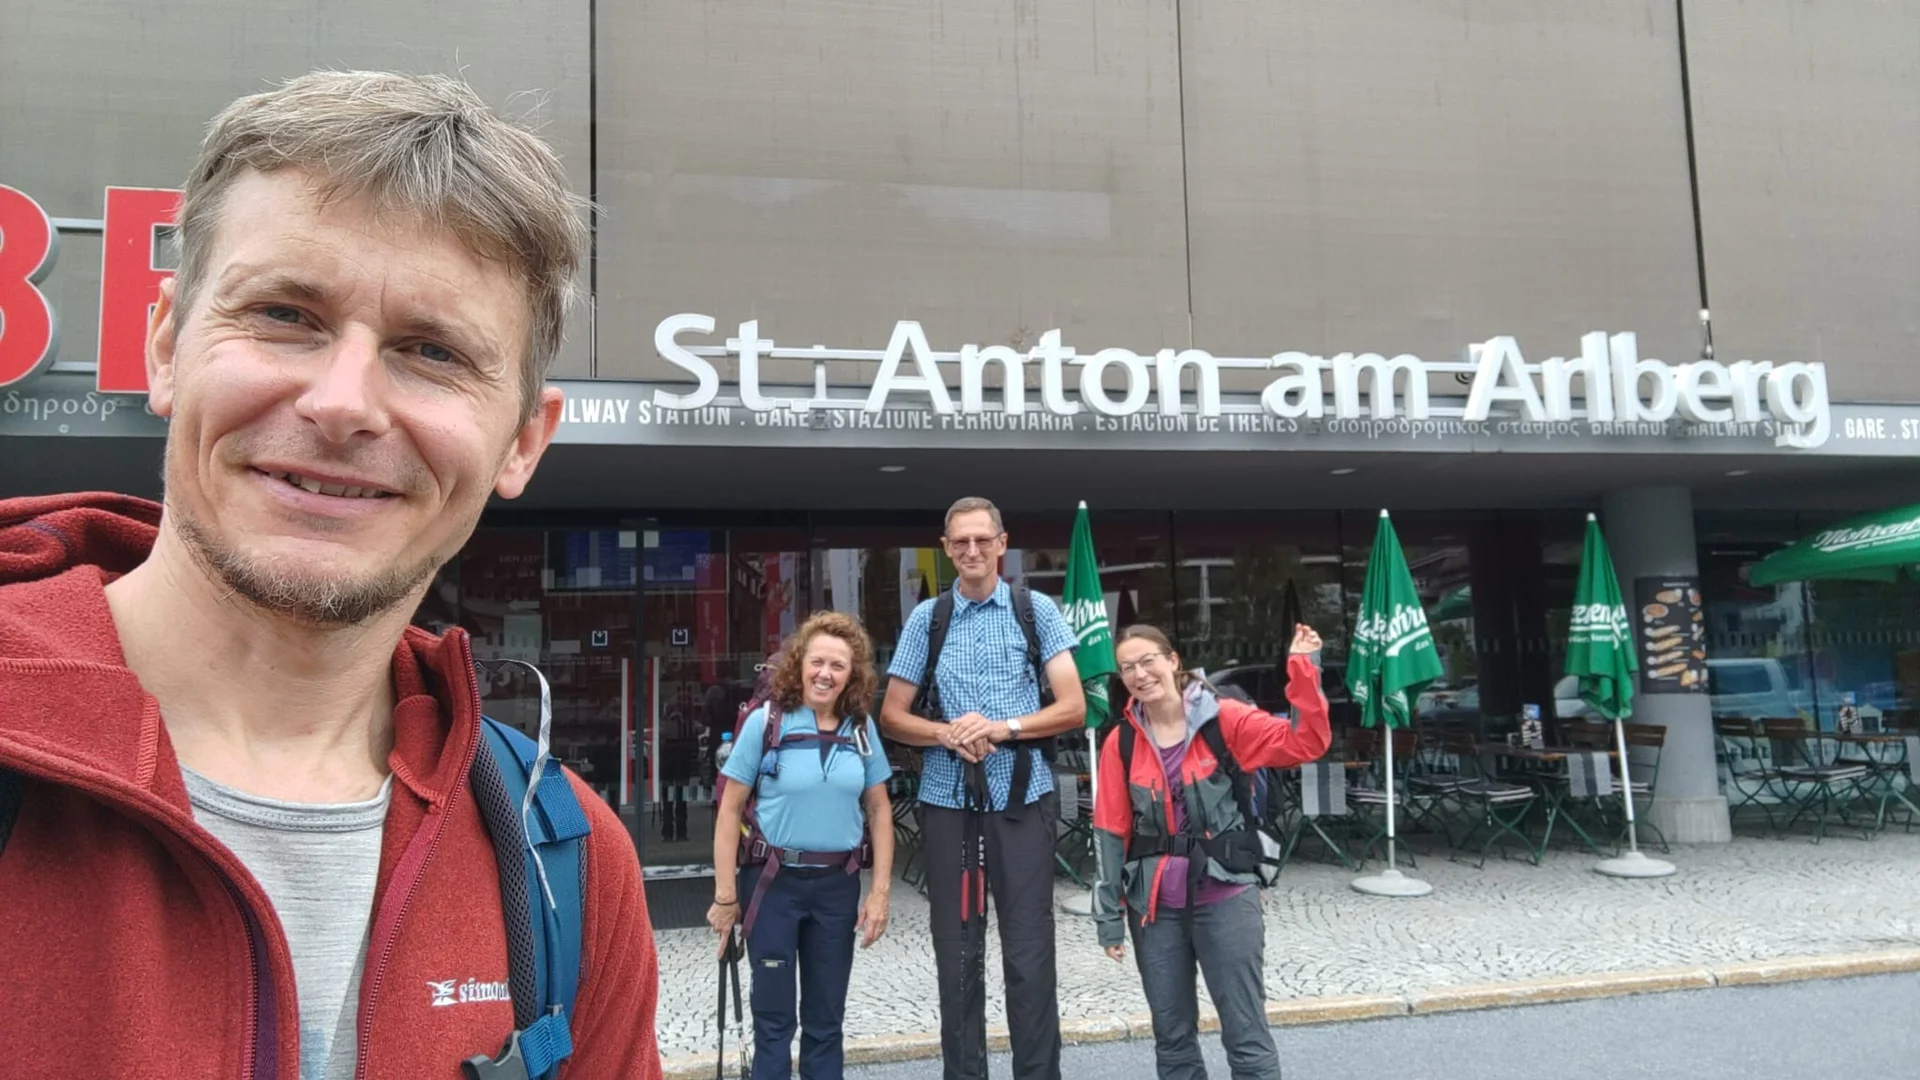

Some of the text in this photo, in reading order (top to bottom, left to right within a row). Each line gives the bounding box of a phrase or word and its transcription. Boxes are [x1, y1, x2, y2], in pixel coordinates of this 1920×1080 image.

[653, 313, 1830, 448] St. Anton am Arlberg
[1845, 418, 1886, 440] GARE
